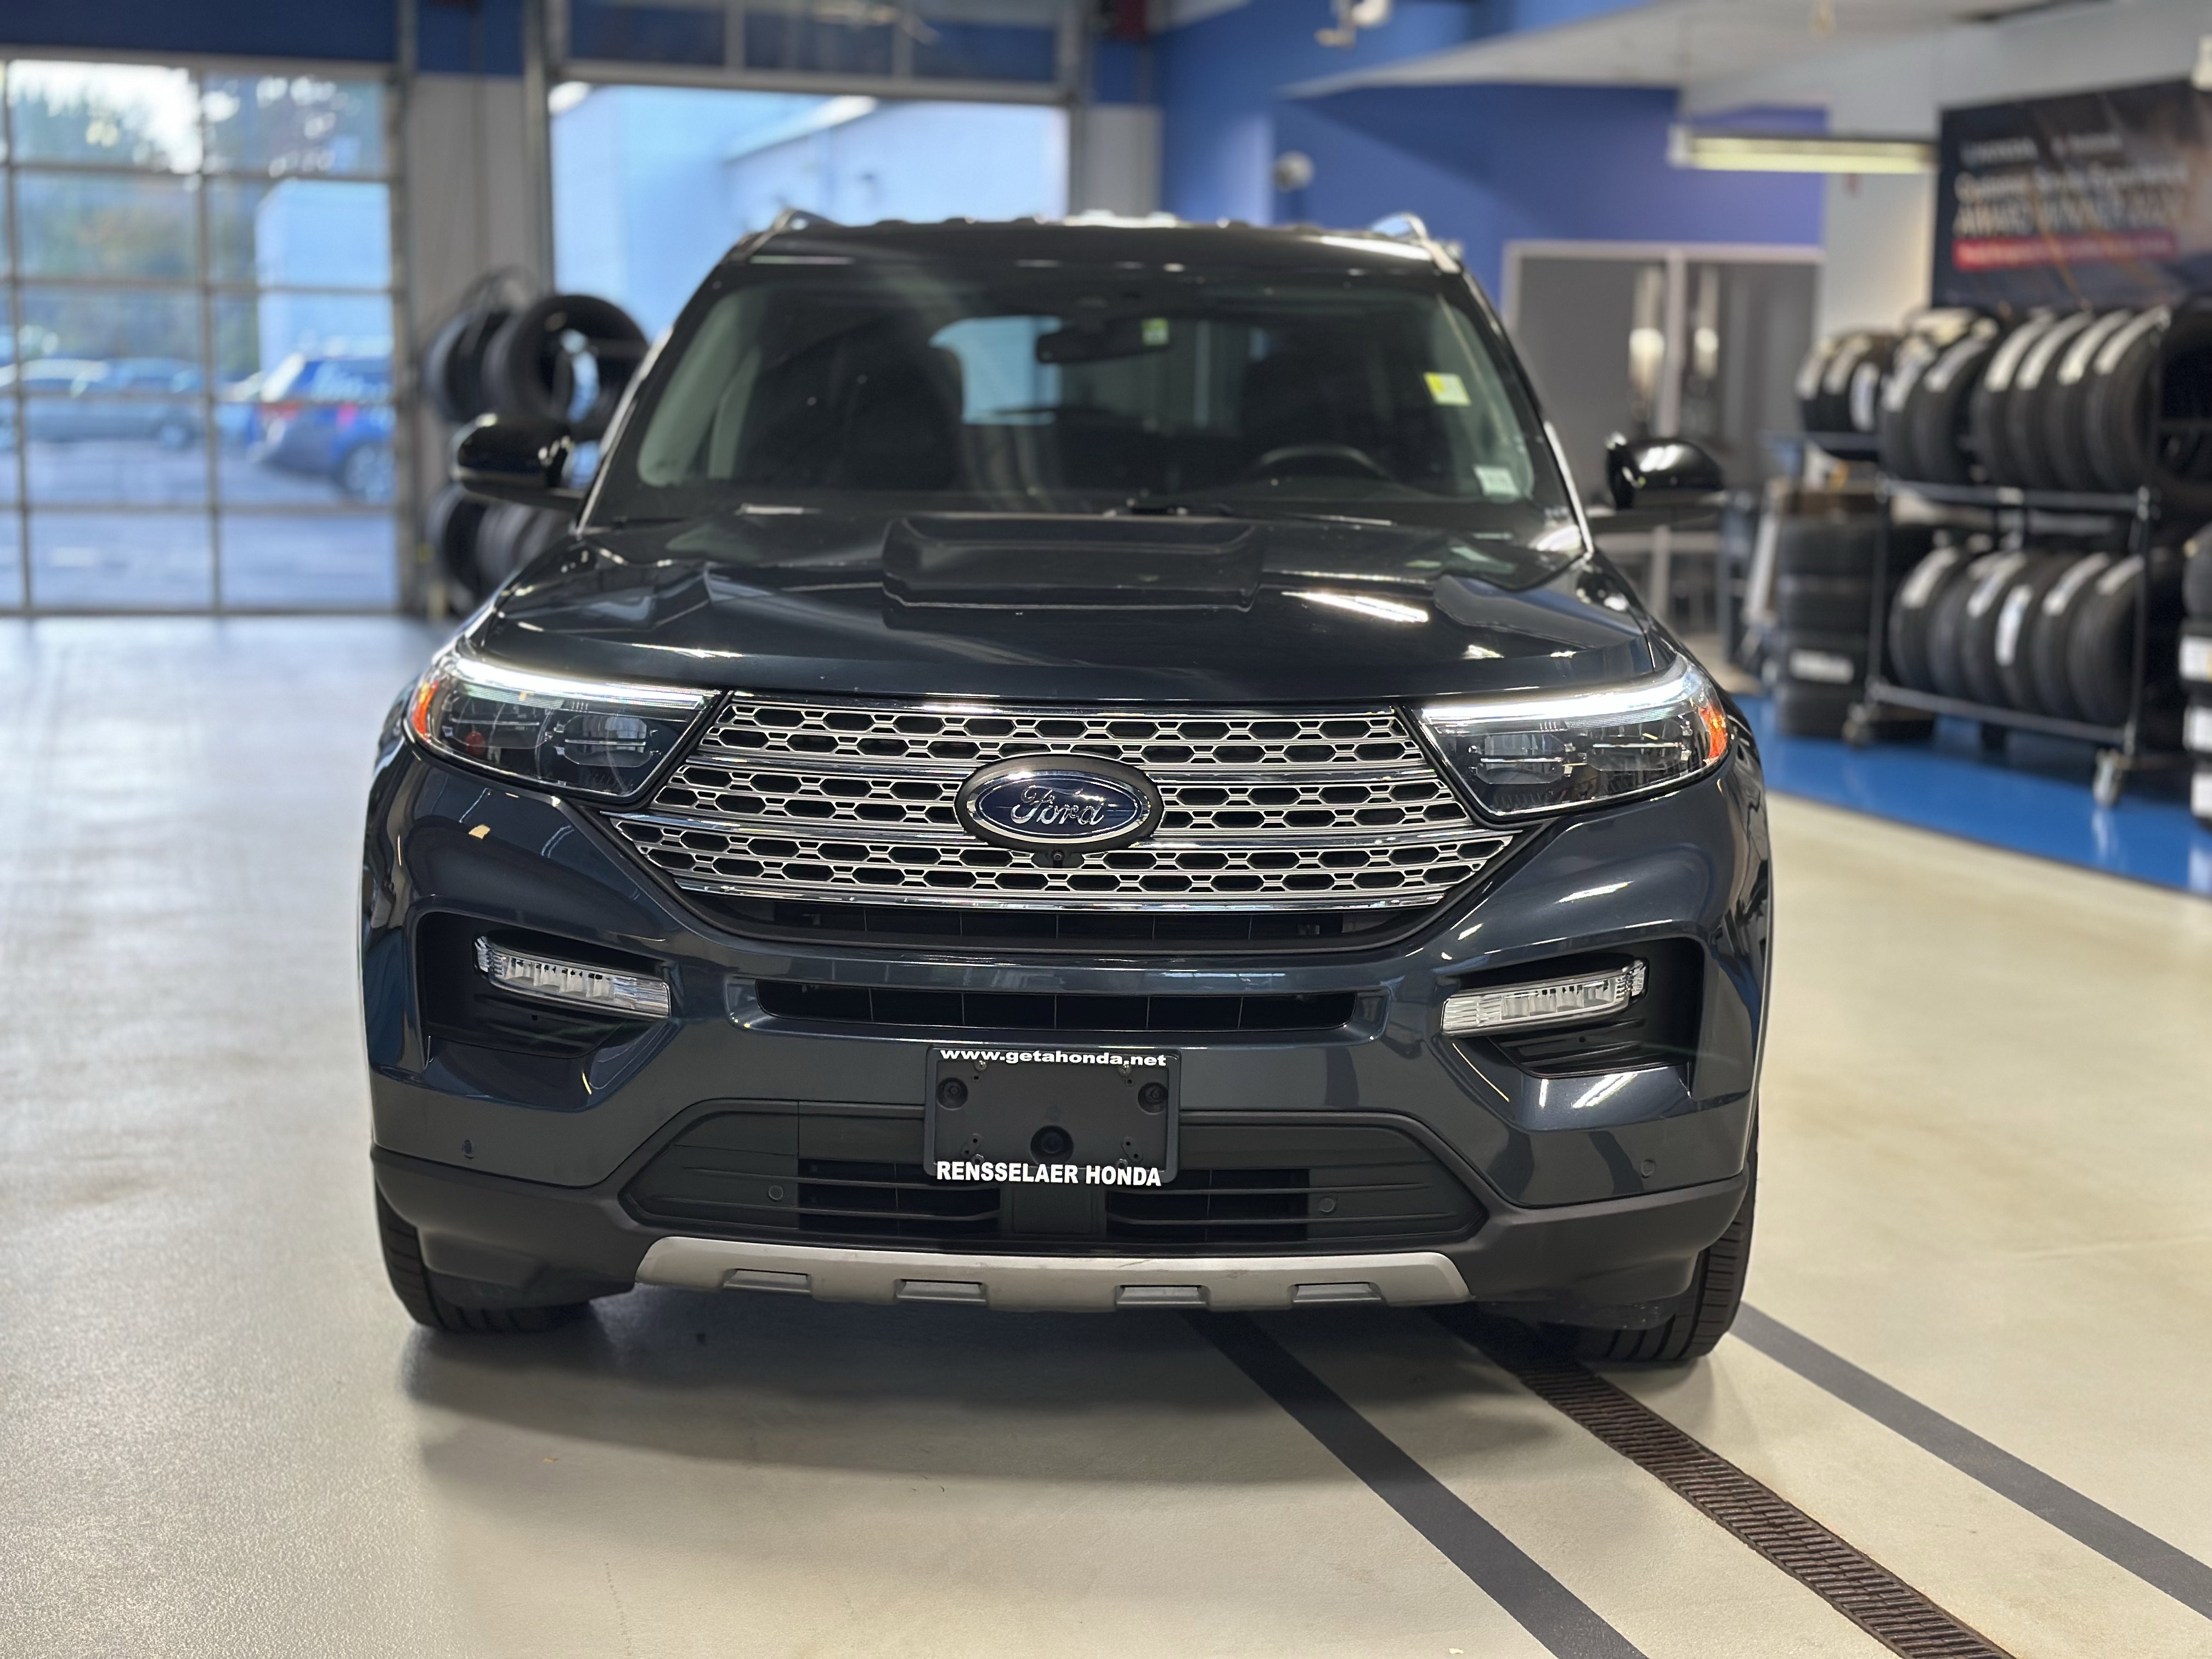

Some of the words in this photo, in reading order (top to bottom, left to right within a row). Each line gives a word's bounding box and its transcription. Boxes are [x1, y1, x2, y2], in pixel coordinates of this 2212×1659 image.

[1011, 785, 1106, 825] Ford
[940, 1049, 1167, 1066] www.getahonda.net
[936, 1161, 1079, 1184] RENSSELAER
[1085, 1165, 1162, 1187] HONDA
